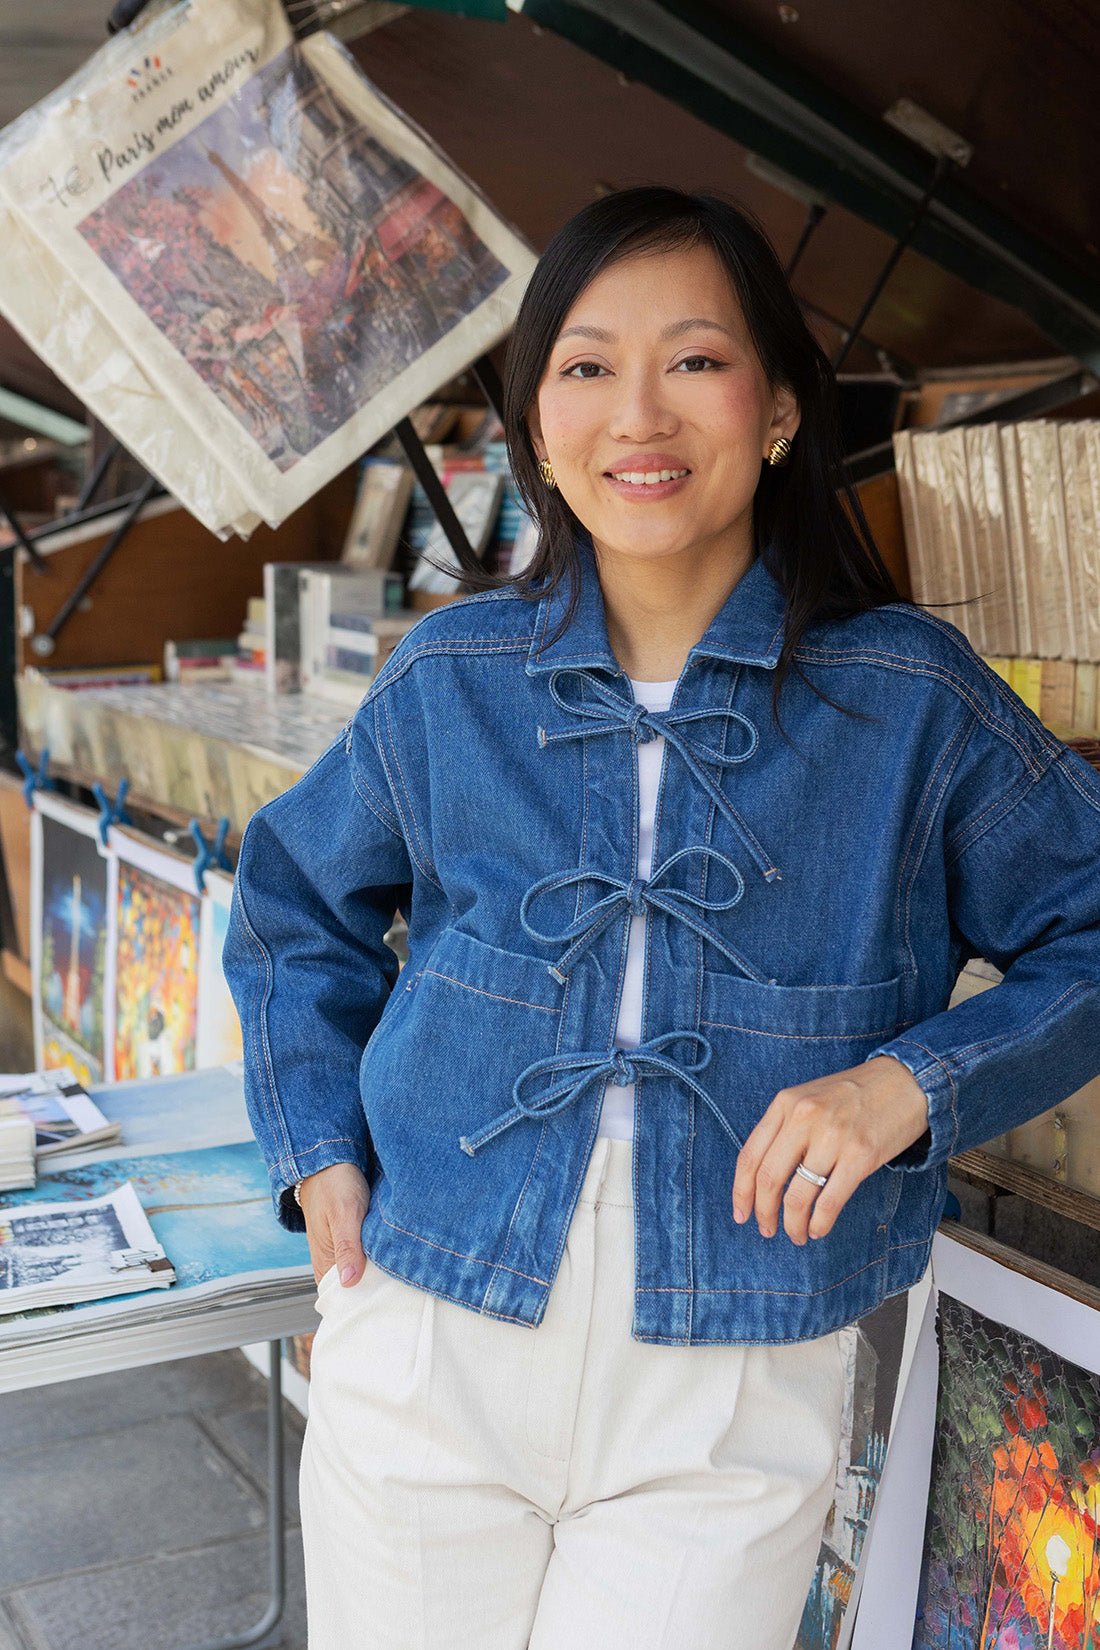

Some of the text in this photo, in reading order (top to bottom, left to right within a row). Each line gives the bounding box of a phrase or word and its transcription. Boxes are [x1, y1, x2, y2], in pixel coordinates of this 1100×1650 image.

[97, 48, 260, 182] Paris mon amour
